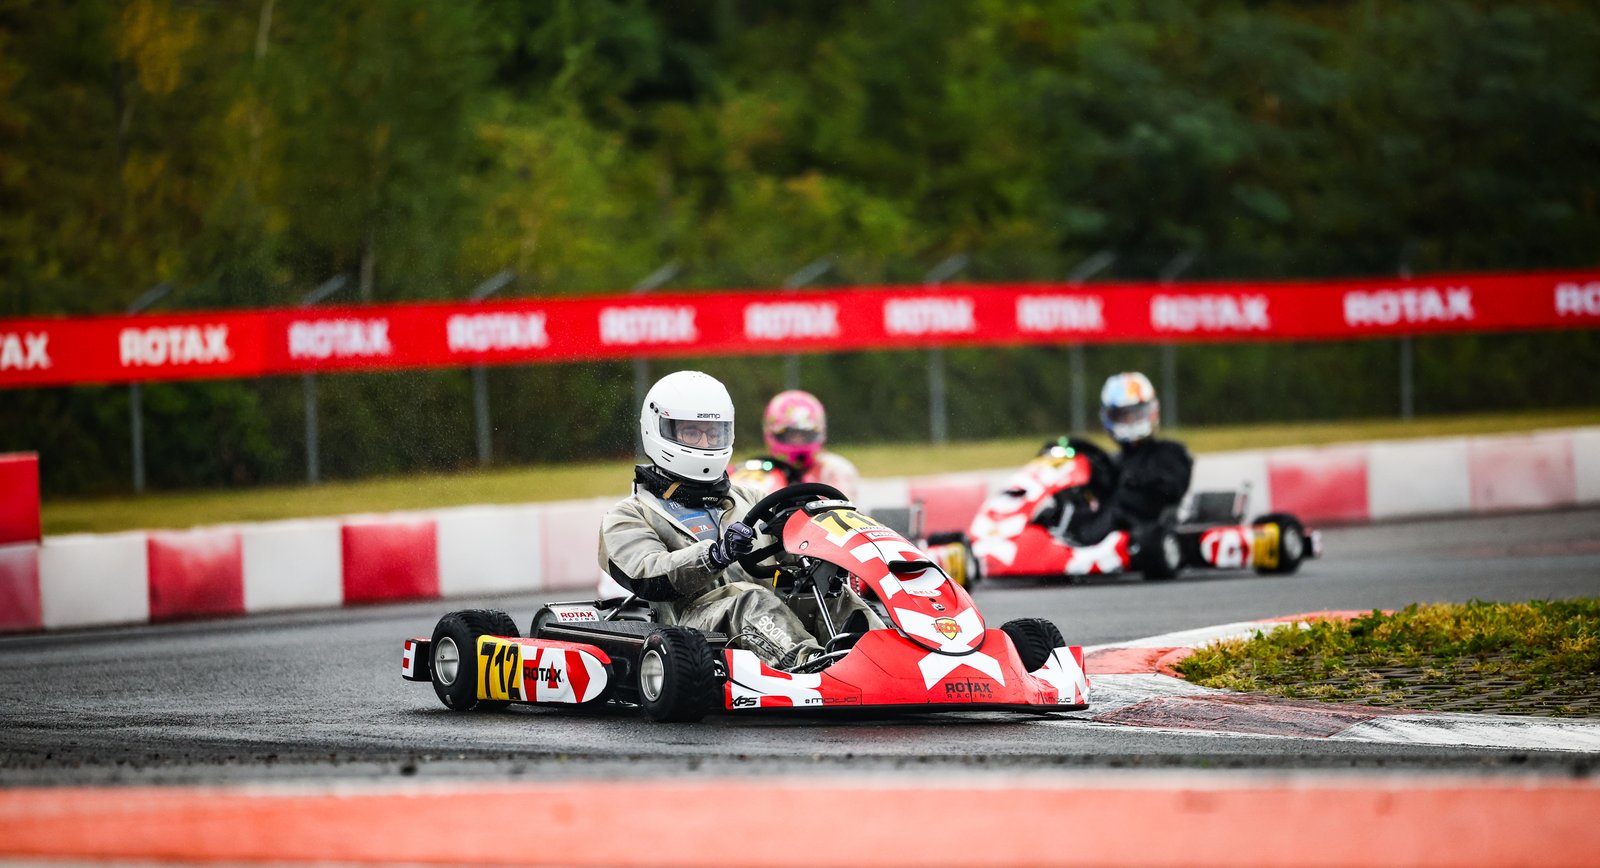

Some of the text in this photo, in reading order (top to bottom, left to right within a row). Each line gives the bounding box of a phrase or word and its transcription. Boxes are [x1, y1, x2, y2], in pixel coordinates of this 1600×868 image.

[1344, 289, 1472, 324] ROTAX
[119, 326, 229, 365] ROTAX
[288, 319, 391, 358] ROTAX
[480, 641, 522, 700] 712
[523, 666, 563, 683] ROTAX
[945, 682, 992, 694] ROTAX
[728, 695, 759, 707] XPS
